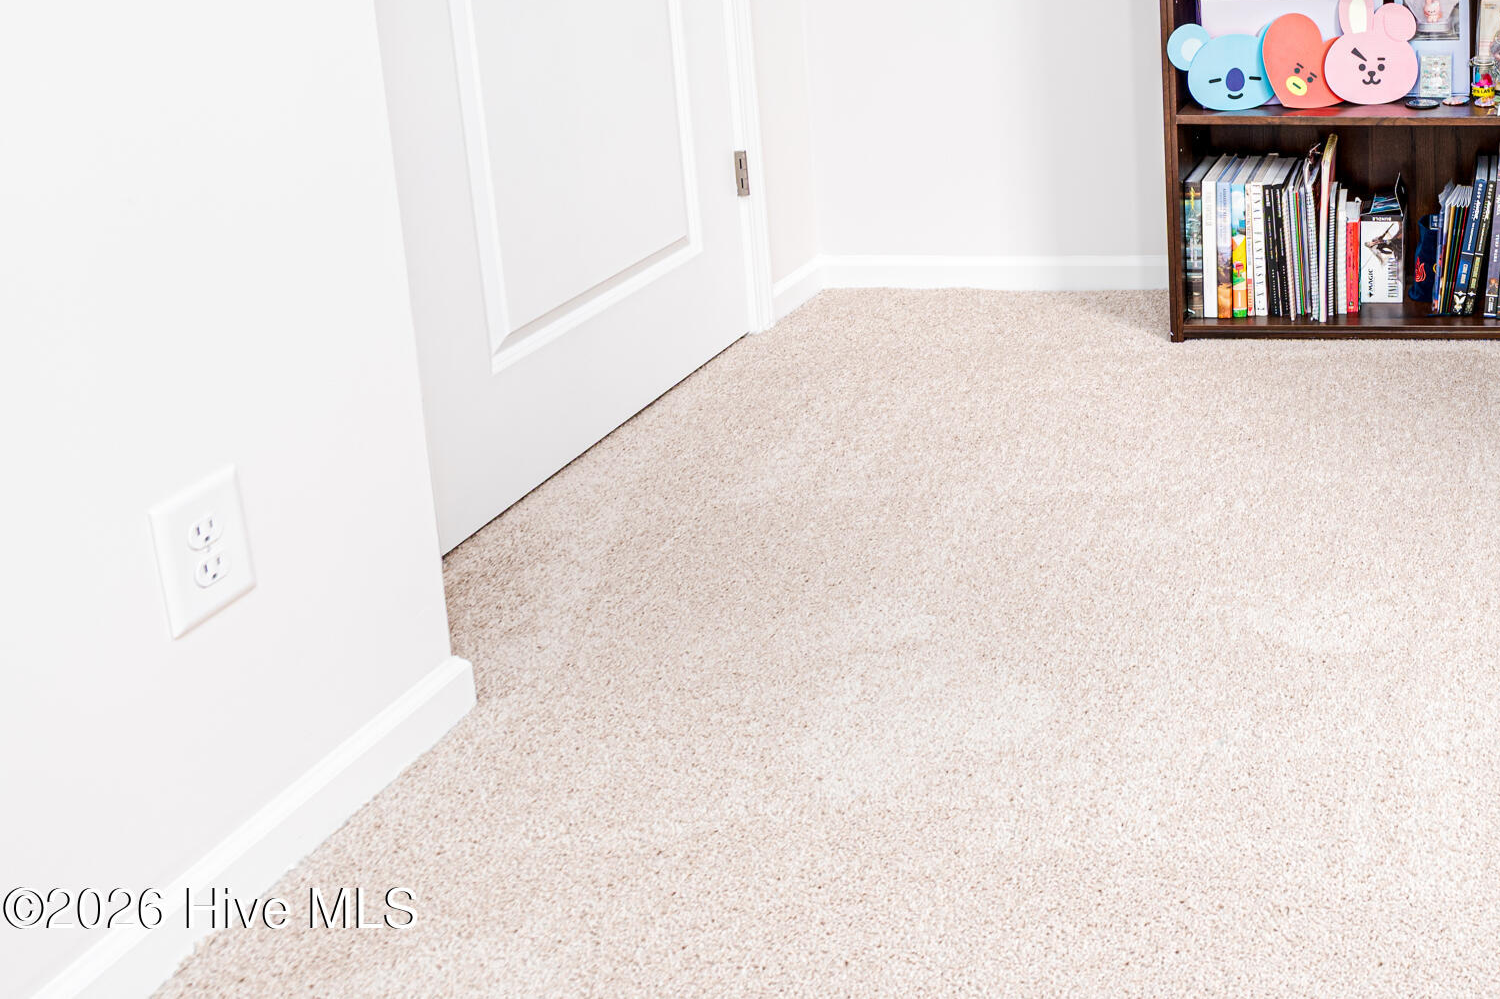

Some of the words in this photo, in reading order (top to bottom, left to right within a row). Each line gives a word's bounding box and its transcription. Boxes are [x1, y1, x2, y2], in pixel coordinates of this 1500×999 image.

[1252, 184, 1262, 222] FINAL
[1253, 232, 1264, 288] FANTASY
[1388, 282, 1398, 298] FINAL
